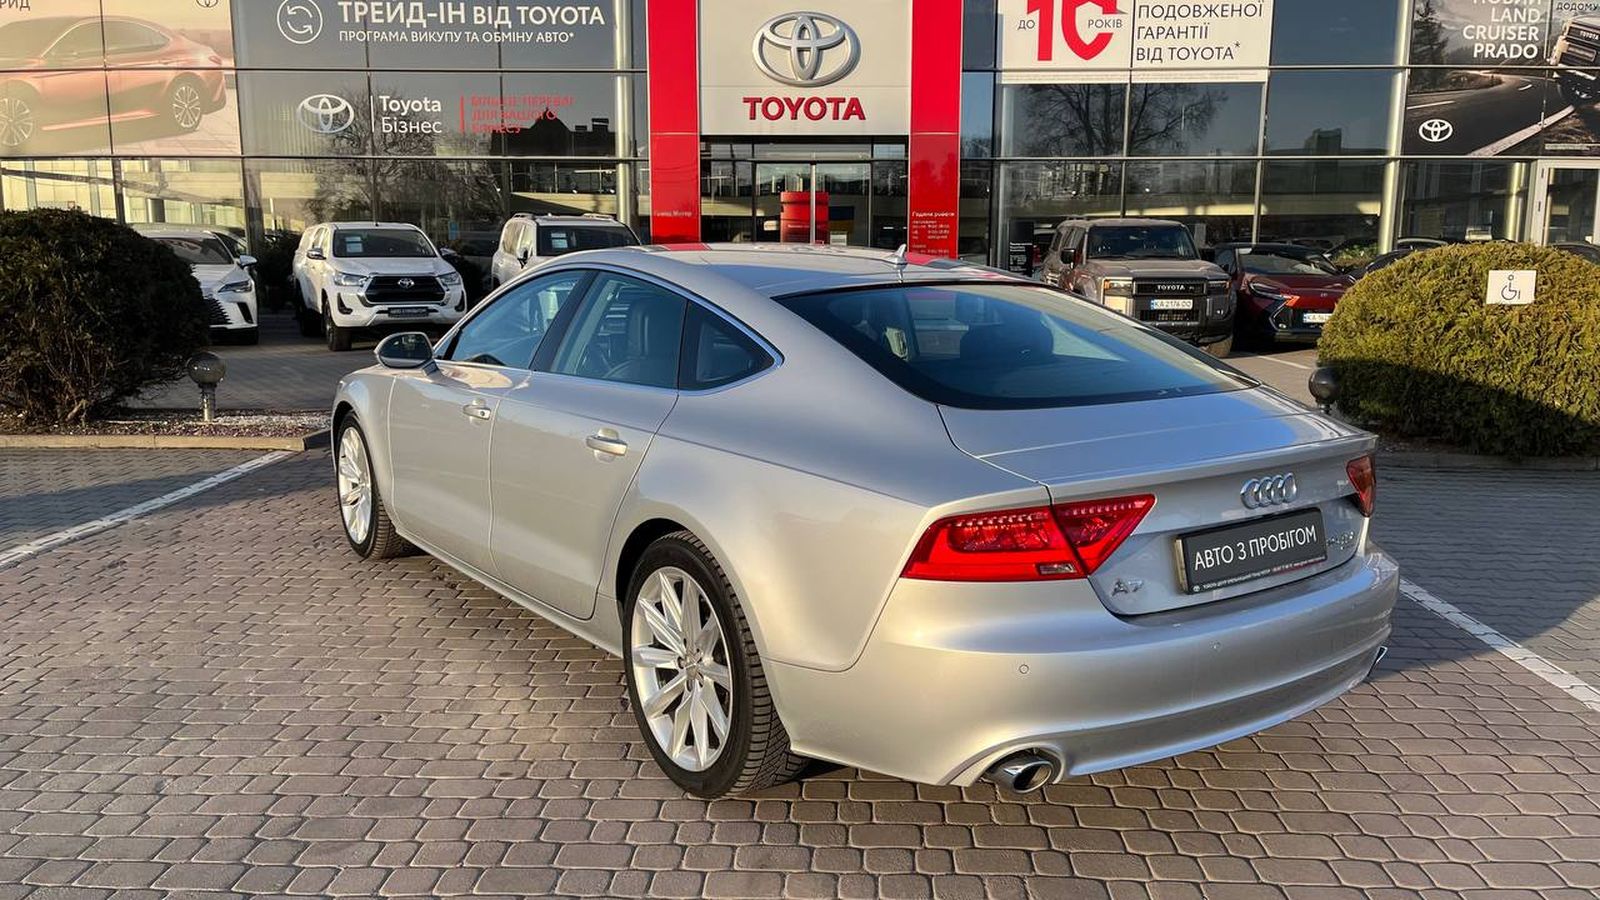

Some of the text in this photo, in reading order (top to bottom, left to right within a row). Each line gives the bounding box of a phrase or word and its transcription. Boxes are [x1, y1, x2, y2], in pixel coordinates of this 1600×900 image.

[473, 6, 512, 29] ВІД
[516, 6, 605, 25] TOYOTA
[1138, 0, 1265, 20] ПОДОВЖЕНОЇ
[1491, 7, 1540, 23] LAND
[1017, 20, 1036, 30] ДО
[1088, 19, 1123, 29] РОКІВ
[1137, 22, 1210, 39] ГАРАНТІЇ
[1463, 25, 1540, 41] CRUISER
[339, 31, 408, 42] ПРОГРАМА
[411, 31, 462, 42] ВИКУПУ
[464, 31, 480, 42] ТА
[482, 31, 533, 42] ОБМІНУ
[1136, 47, 1163, 63] ВІД
[1473, 43, 1538, 59] PRADO
[379, 95, 441, 116] Toyota
[743, 97, 866, 121] TOYOTA
[382, 116, 442, 133] Бізнес
[1194, 545, 1234, 571] АВТО
[1236, 541, 1247, 561] З
[1249, 524, 1317, 558] ПРОБІГОМ
